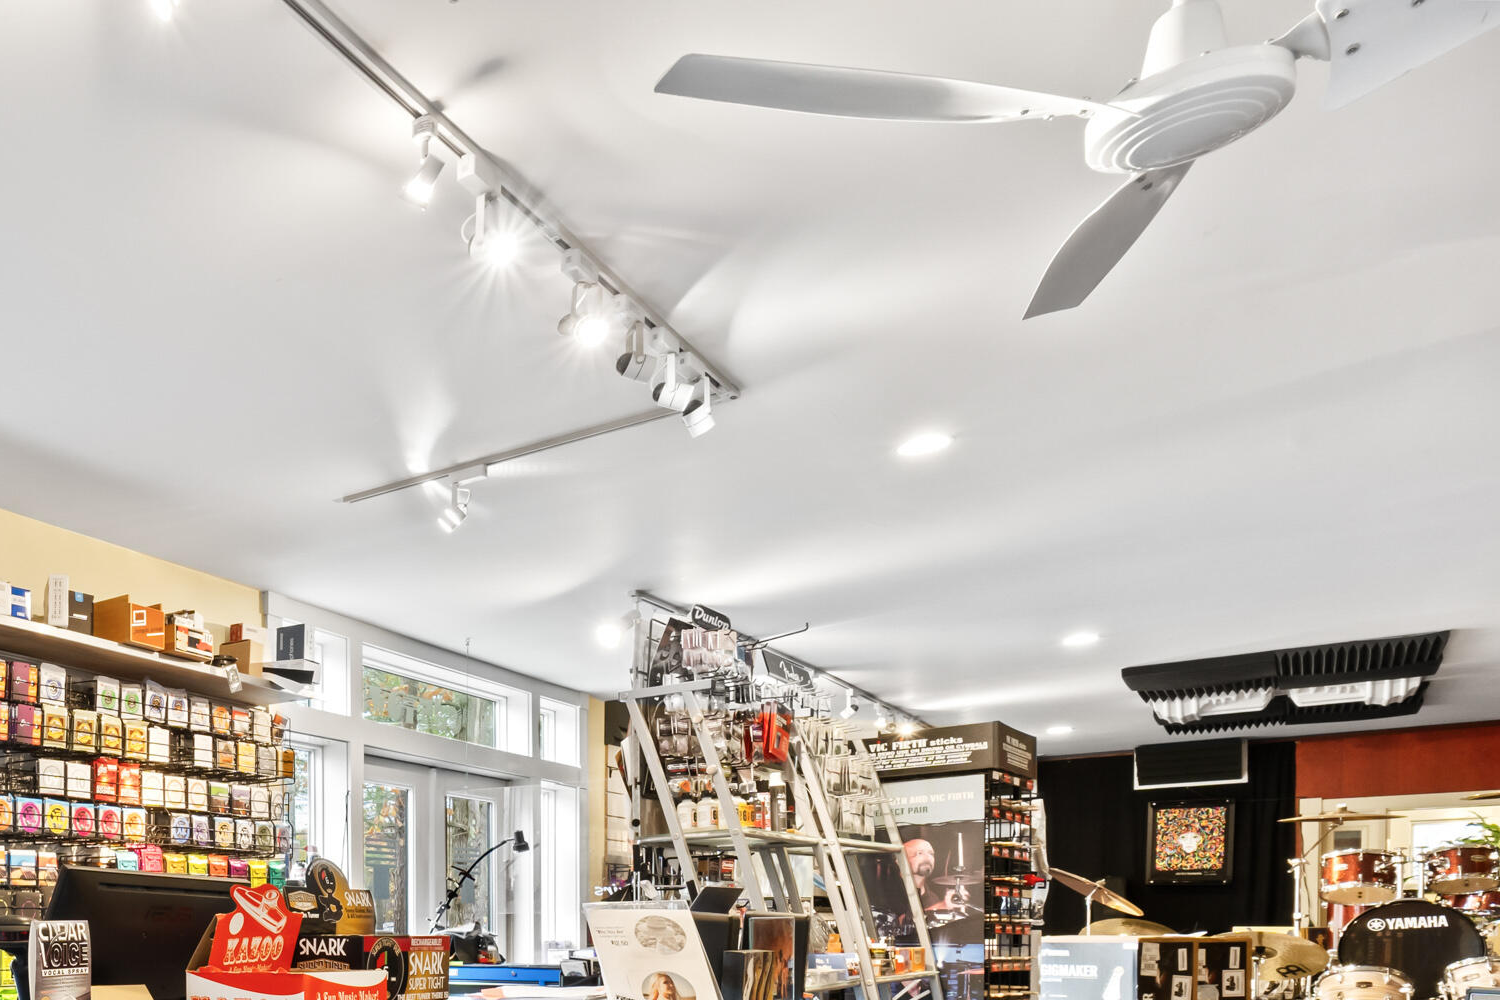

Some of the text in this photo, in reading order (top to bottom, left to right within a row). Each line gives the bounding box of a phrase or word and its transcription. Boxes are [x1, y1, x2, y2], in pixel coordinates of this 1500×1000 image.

[693, 604, 730, 630] Dunlop
[868, 736, 963, 753] VIC FIRTH sticks
[947, 791, 975, 801] FIRTH
[908, 806, 929, 815] PAIR
[344, 892, 372, 907] SNARK
[1385, 915, 1449, 930] YAMAHA
[223, 934, 285, 965] KAZOO
[299, 937, 347, 957] SNARK
[38, 942, 89, 969] VOICE
[409, 951, 444, 976] SNARK
[1040, 964, 1099, 978] GIGMAKER
[408, 976, 445, 991] SUPER TIGHT
